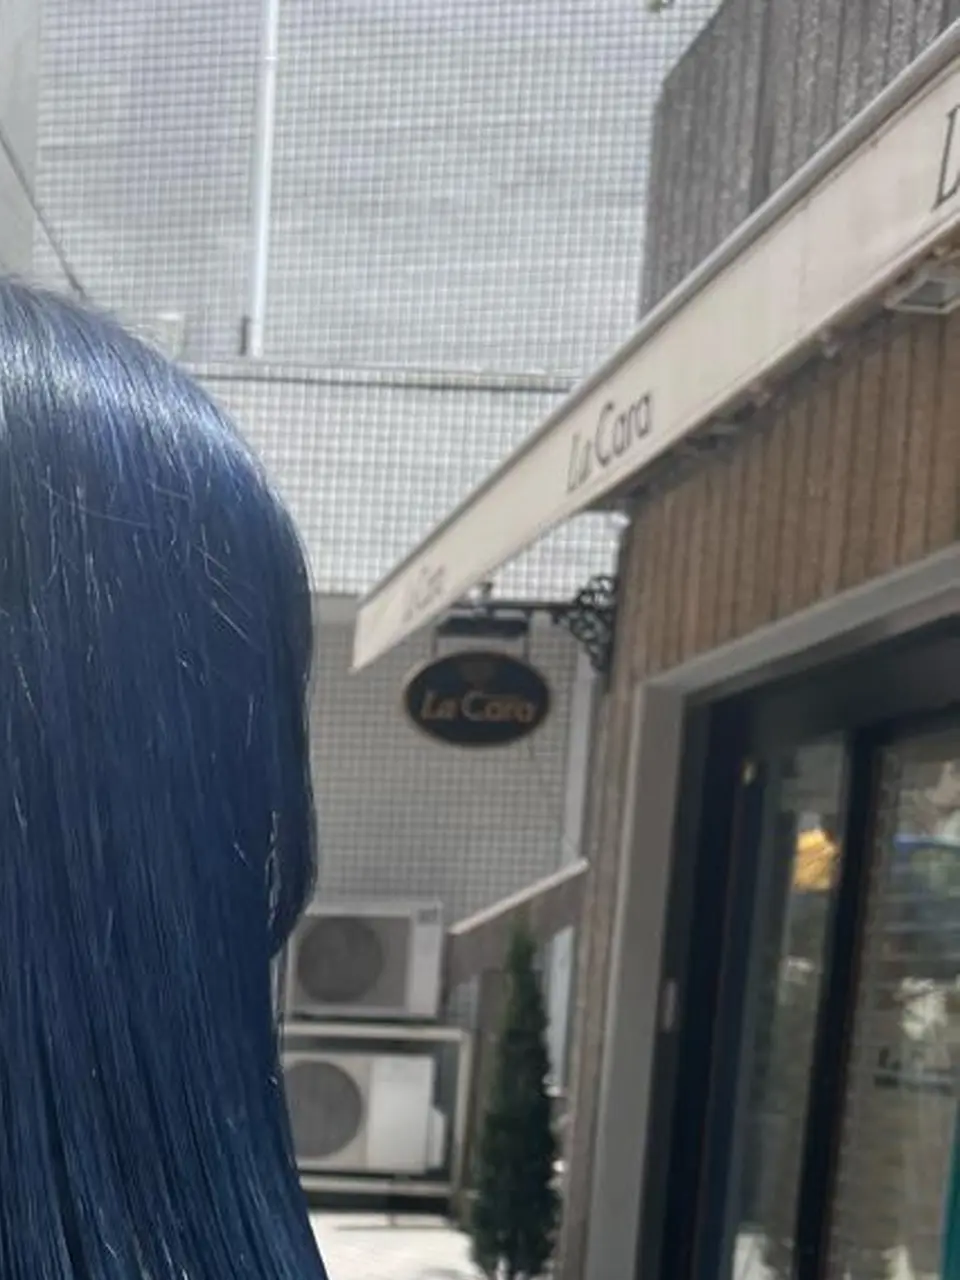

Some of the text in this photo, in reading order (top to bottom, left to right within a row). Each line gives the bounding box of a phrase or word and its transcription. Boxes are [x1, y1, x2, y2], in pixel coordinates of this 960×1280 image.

[566, 392, 652, 493] La Cara
[420, 688, 458, 720] La
